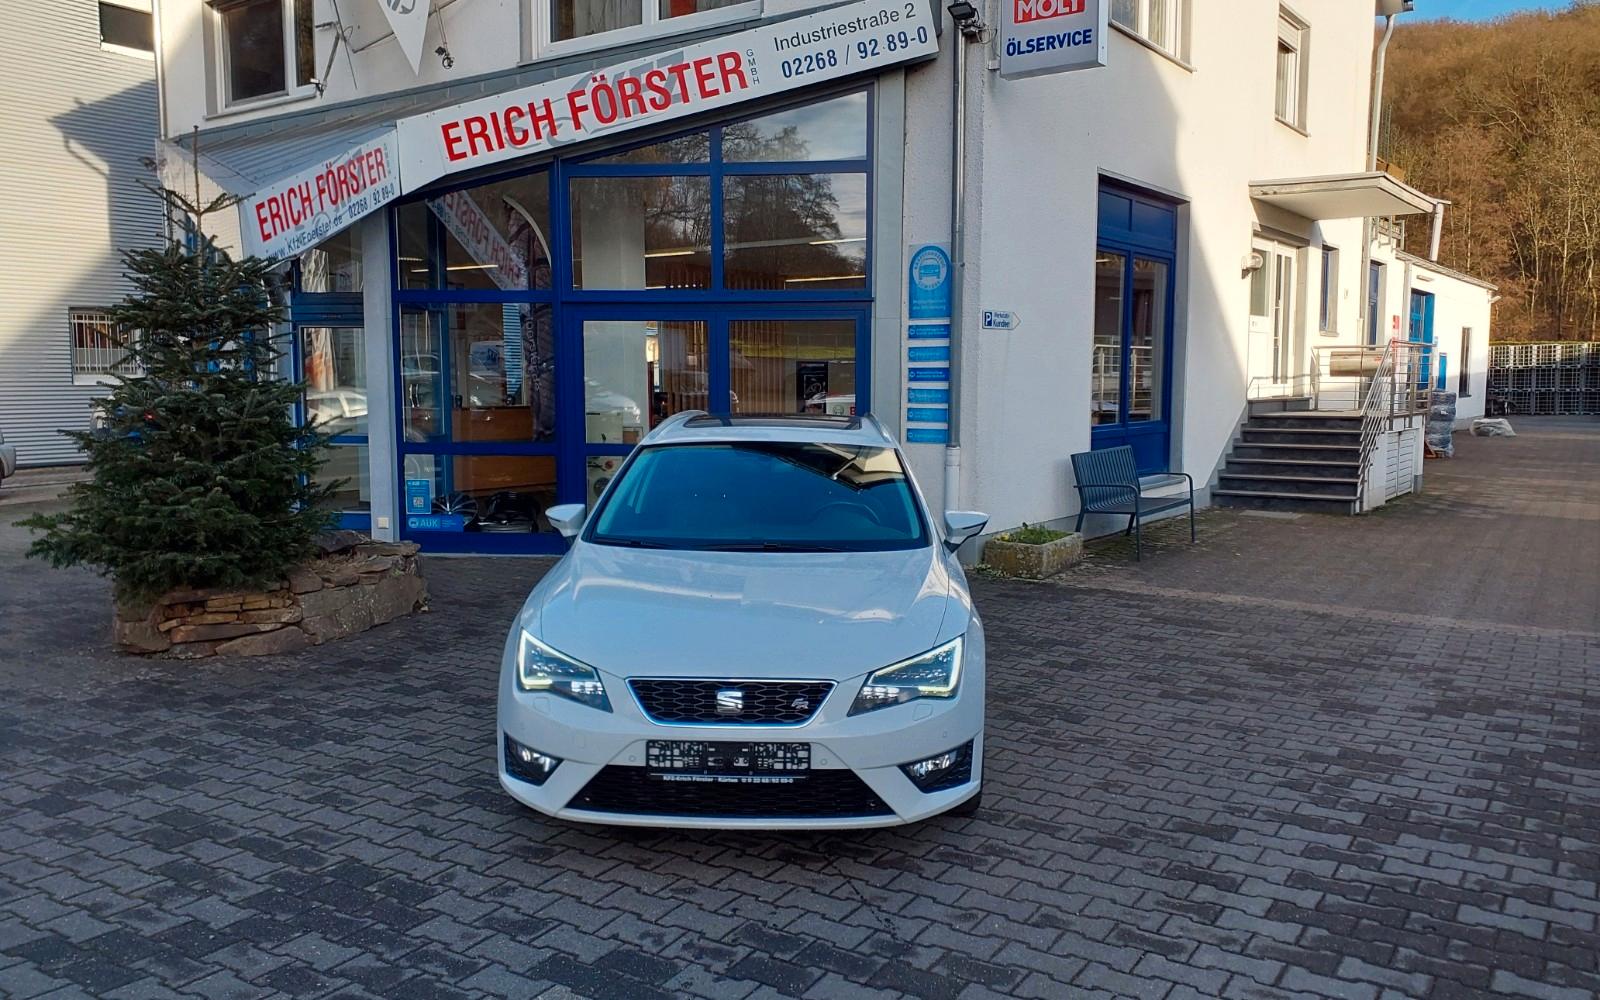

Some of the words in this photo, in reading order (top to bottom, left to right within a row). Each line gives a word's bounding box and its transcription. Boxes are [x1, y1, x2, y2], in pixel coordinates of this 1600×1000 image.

[774, 9, 900, 52] Industriestraße
[904, 2, 916, 19] 2
[781, 49, 837, 79] 02268
[846, 44, 850, 65] /
[857, 38, 880, 60] 92
[887, 25, 928, 52] 89-0
[1006, 28, 1092, 57] ÖLSERVICE
[441, 98, 558, 162] ERICH
[566, 51, 749, 131] FÖRSTER
[255, 180, 314, 242] ERICH
[315, 147, 387, 213] FÖRSTER
[348, 197, 368, 219] 02268
[372, 189, 381, 205] 92
